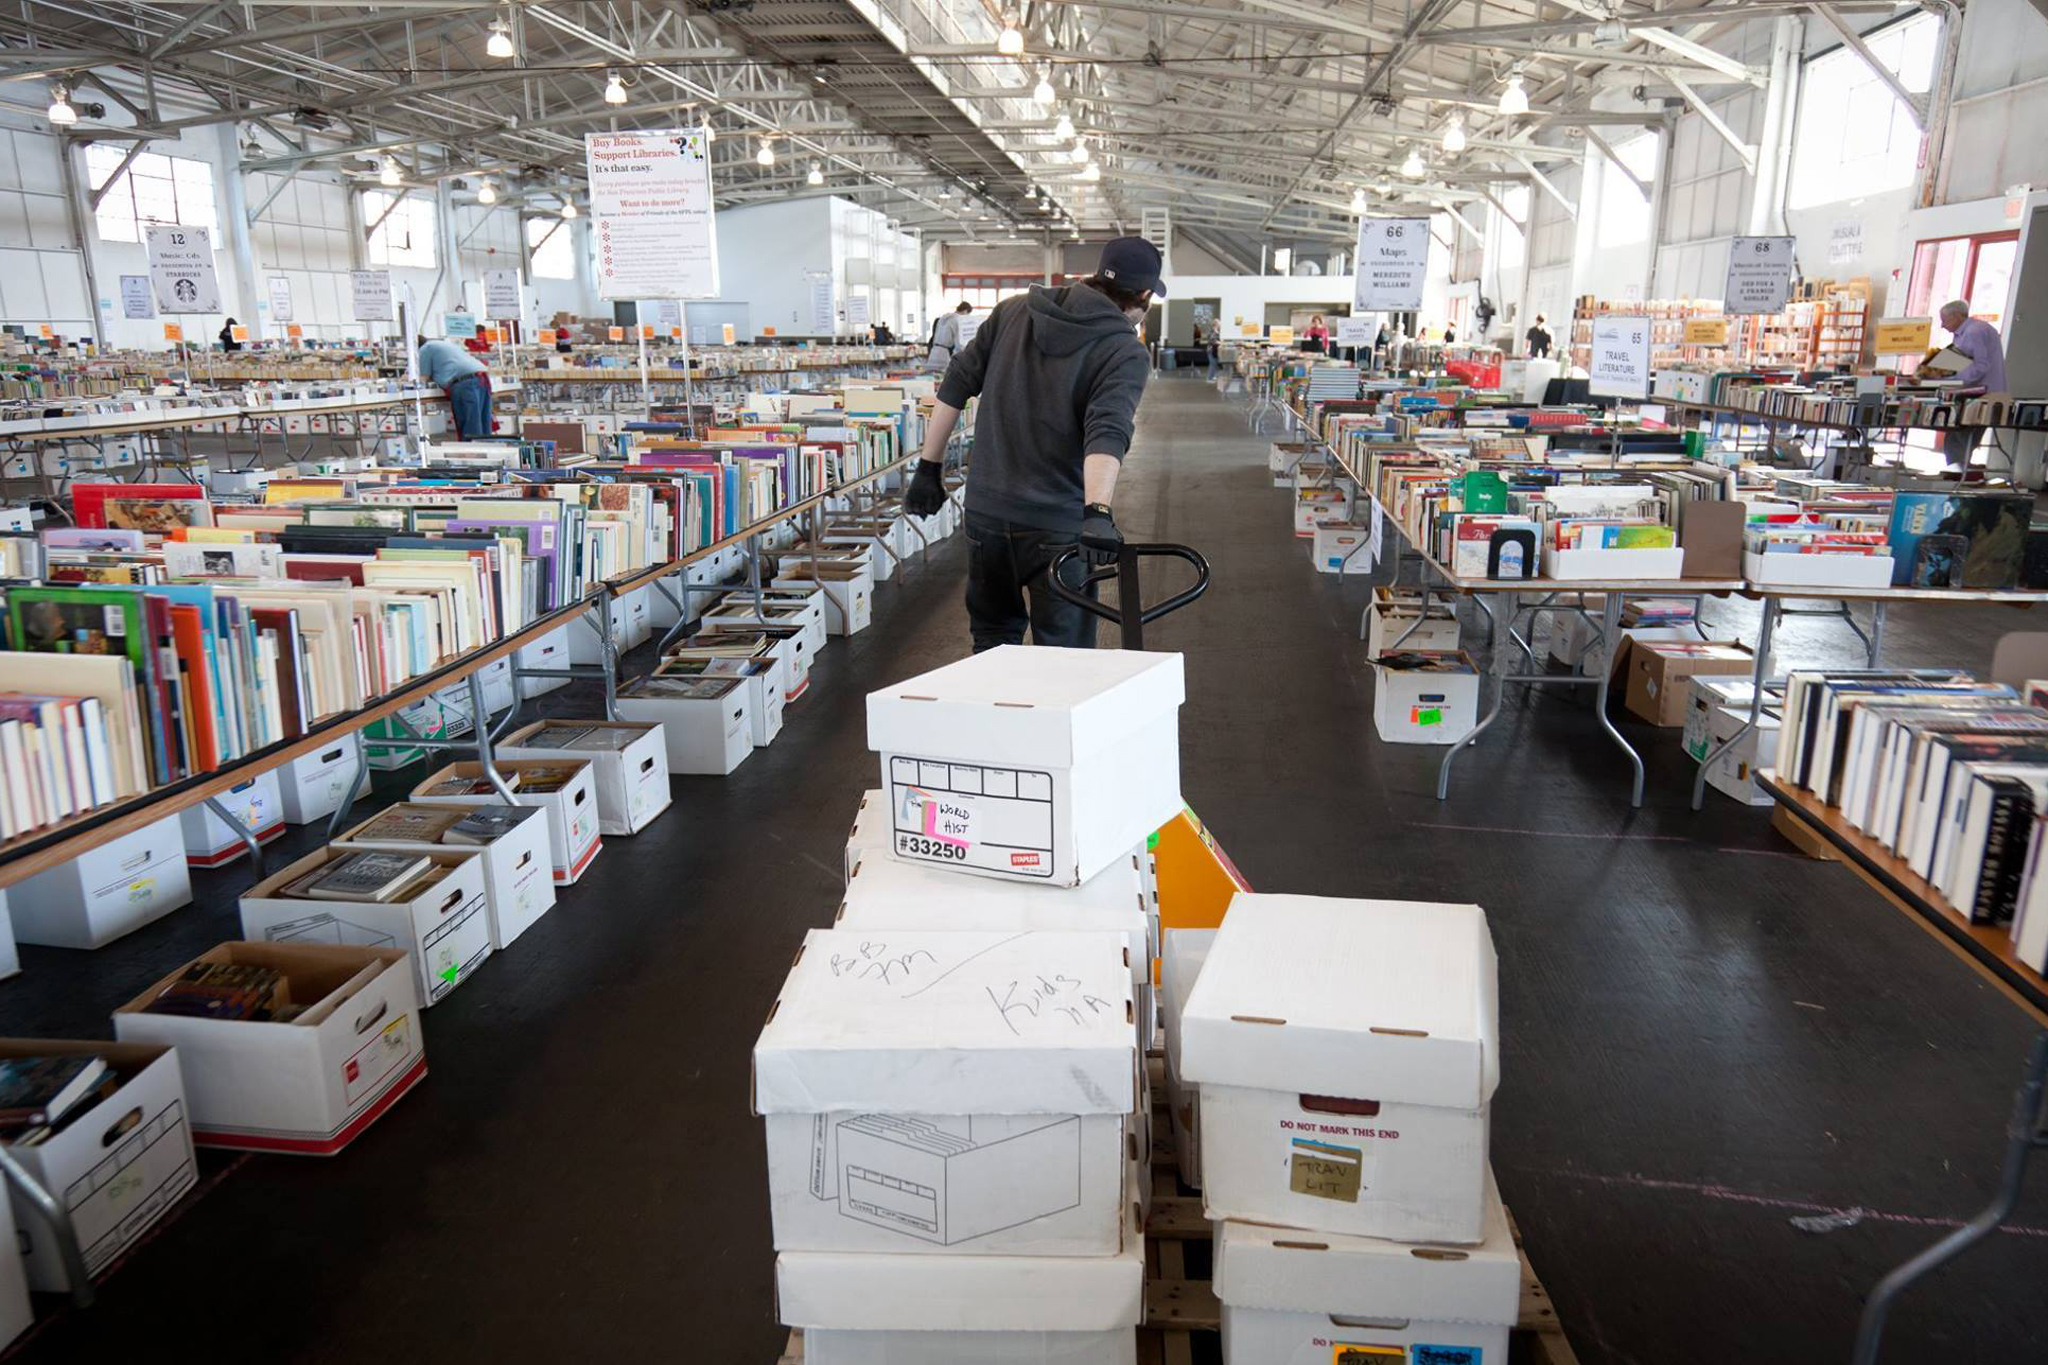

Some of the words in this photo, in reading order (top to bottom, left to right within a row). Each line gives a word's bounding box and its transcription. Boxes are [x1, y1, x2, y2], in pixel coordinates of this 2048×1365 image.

[593, 139, 612, 148] Buy
[614, 136, 643, 147] Books.
[594, 151, 631, 161] Support
[633, 149, 678, 158] Libraries.
[595, 164, 609, 173] It's
[611, 164, 628, 172] that
[631, 164, 653, 174] easy.
[620, 200, 639, 208] Want
[1386, 226, 1404, 238] 66
[171, 233, 185, 245] 12
[1380, 247, 1407, 258] Maps
[1755, 242, 1770, 253] 68
[1372, 271, 1411, 279] MEREDITH
[1631, 332, 1642, 344] 65
[1605, 350, 1630, 362] TRAVEL
[1598, 363, 1635, 374] LITERATURE
[940, 804, 970, 820] WORLD
[944, 819, 969, 834] HIST
[899, 835, 967, 860] #33250
[1012, 855, 1039, 864] STAPLES
[1280, 1120, 1294, 1129] DO
[1297, 1122, 1317, 1132] NOT
[1319, 1124, 1349, 1135] MARK
[1353, 1127, 1376, 1138] THIS
[1378, 1130, 1400, 1139] END
[1298, 1161, 1348, 1177] TRAV
[1306, 1179, 1341, 1195] LIT
[1312, 1338, 1327, 1347] DO
